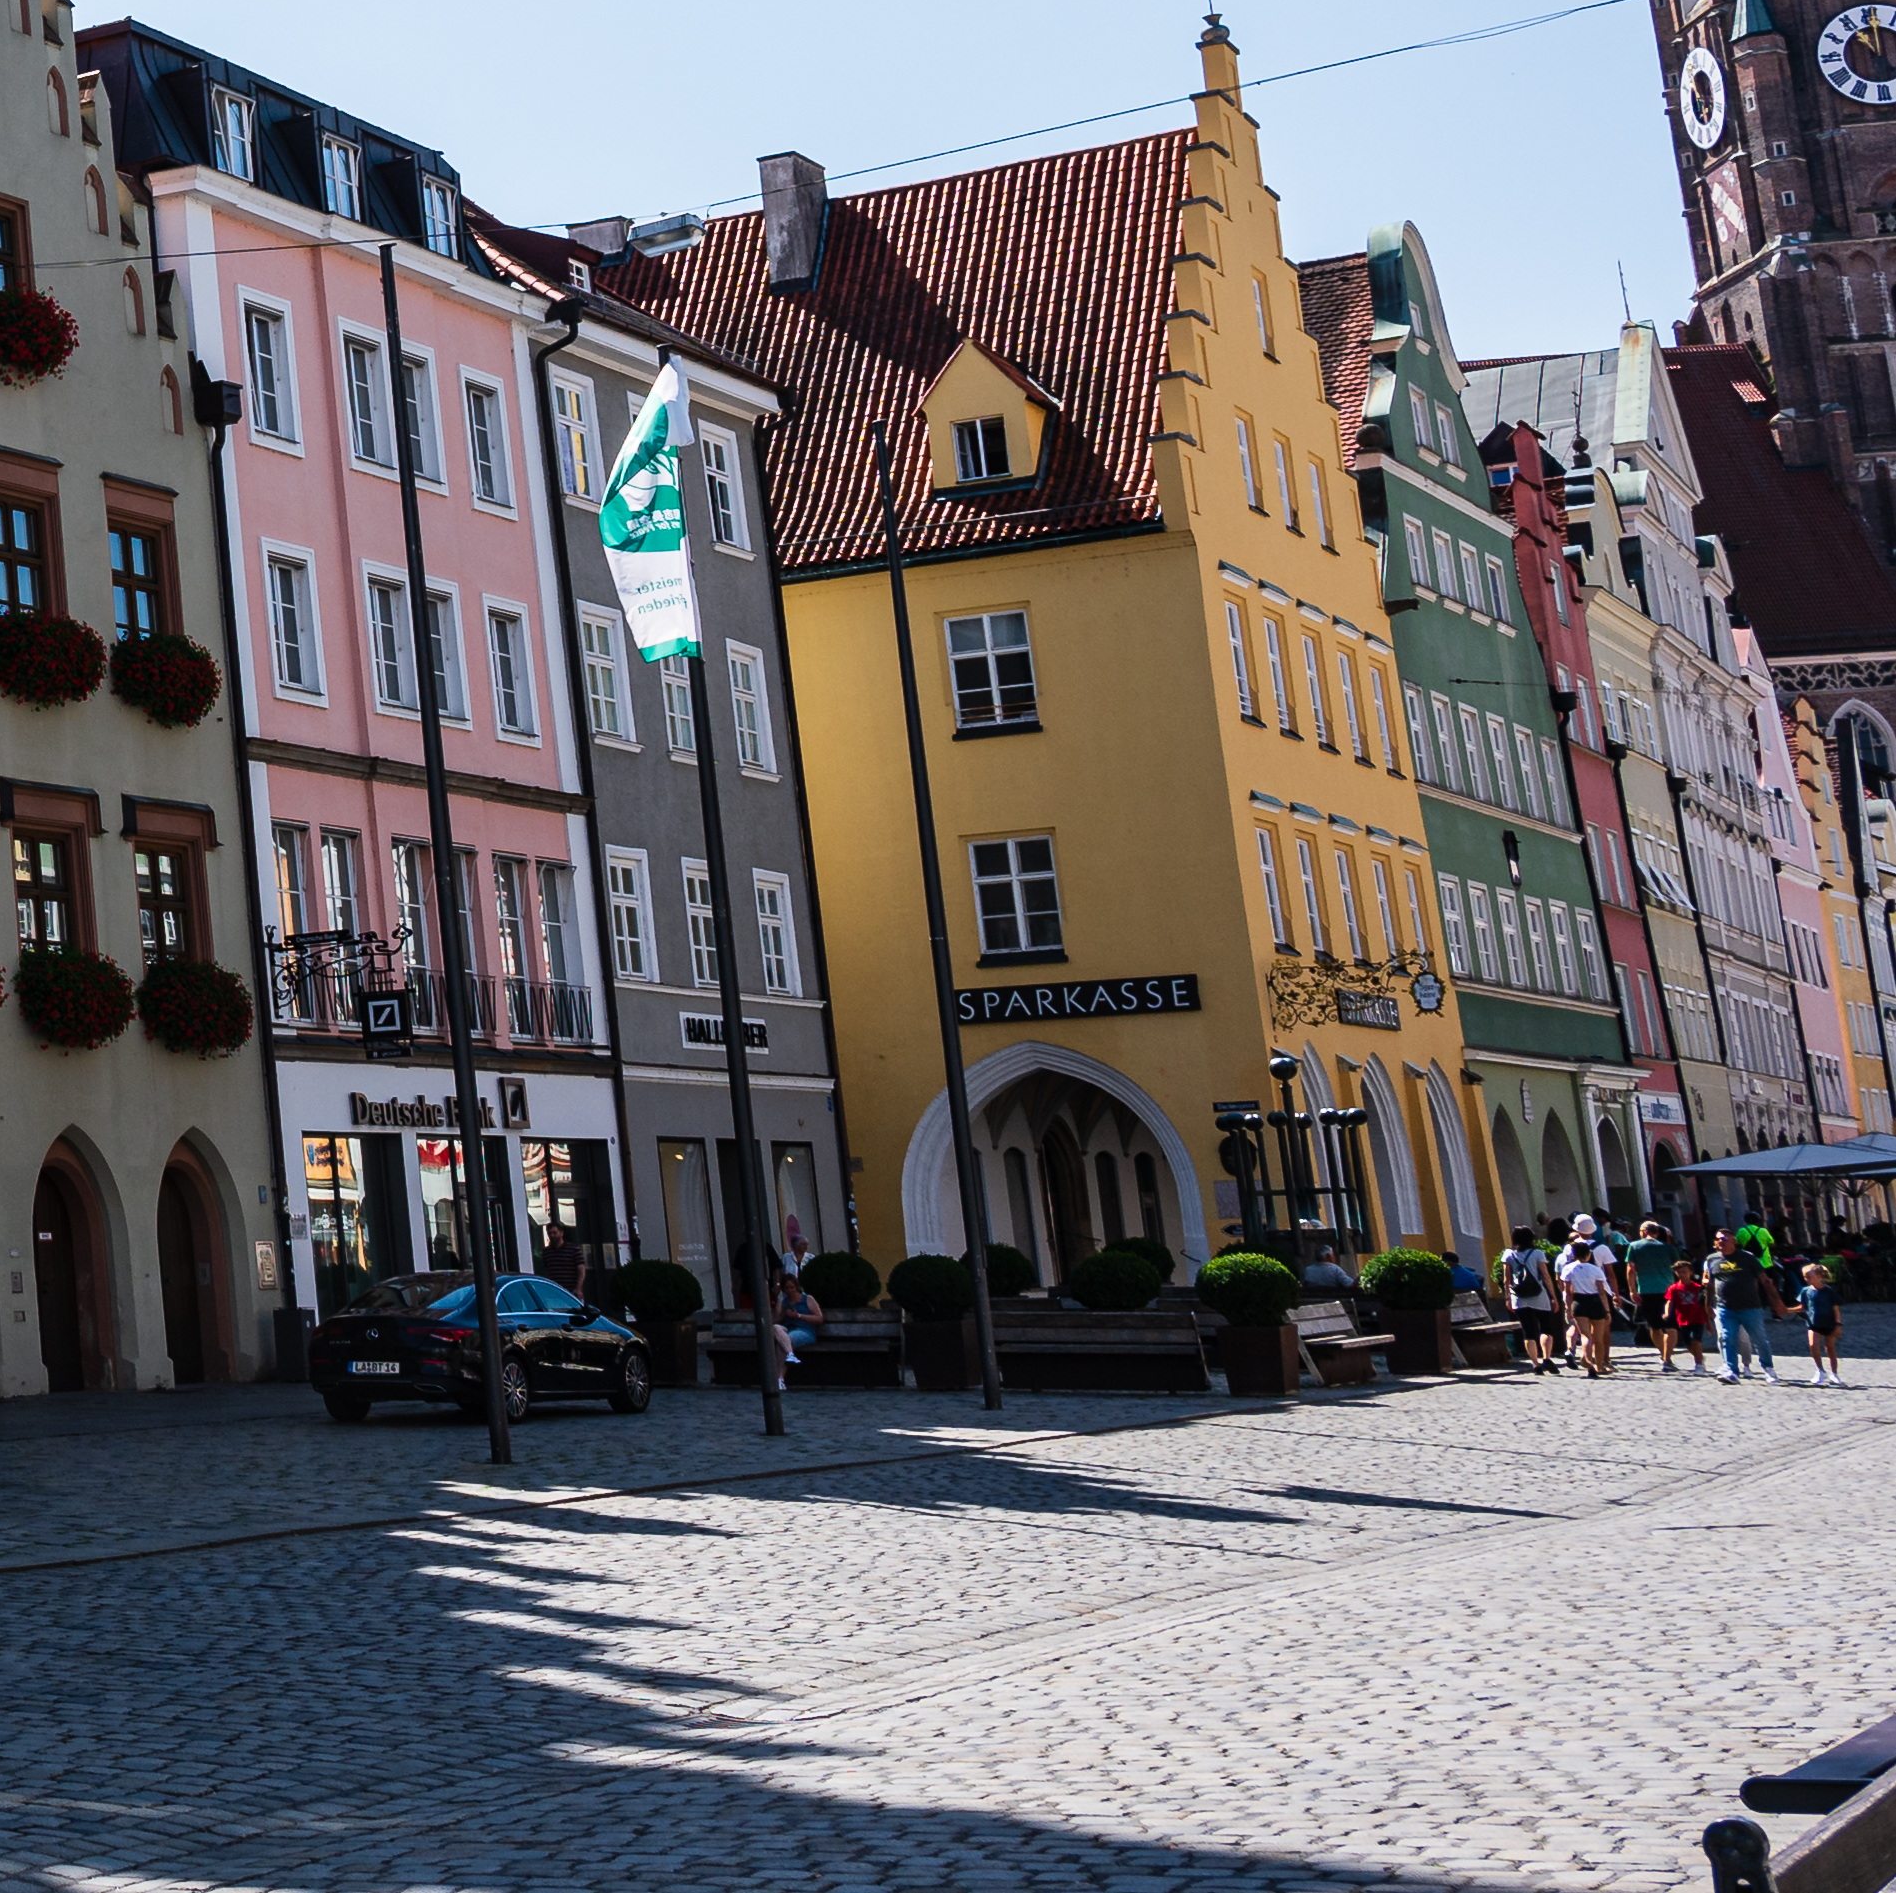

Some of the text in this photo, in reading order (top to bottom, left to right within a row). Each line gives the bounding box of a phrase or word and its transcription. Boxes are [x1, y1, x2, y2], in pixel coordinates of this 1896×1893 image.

[957, 977, 1191, 1022] SPARKASSE
[684, 1016, 768, 1048] HALLBER
[349, 1091, 496, 1128] Deutsche Bnk
[355, 1363, 366, 1371] LA
